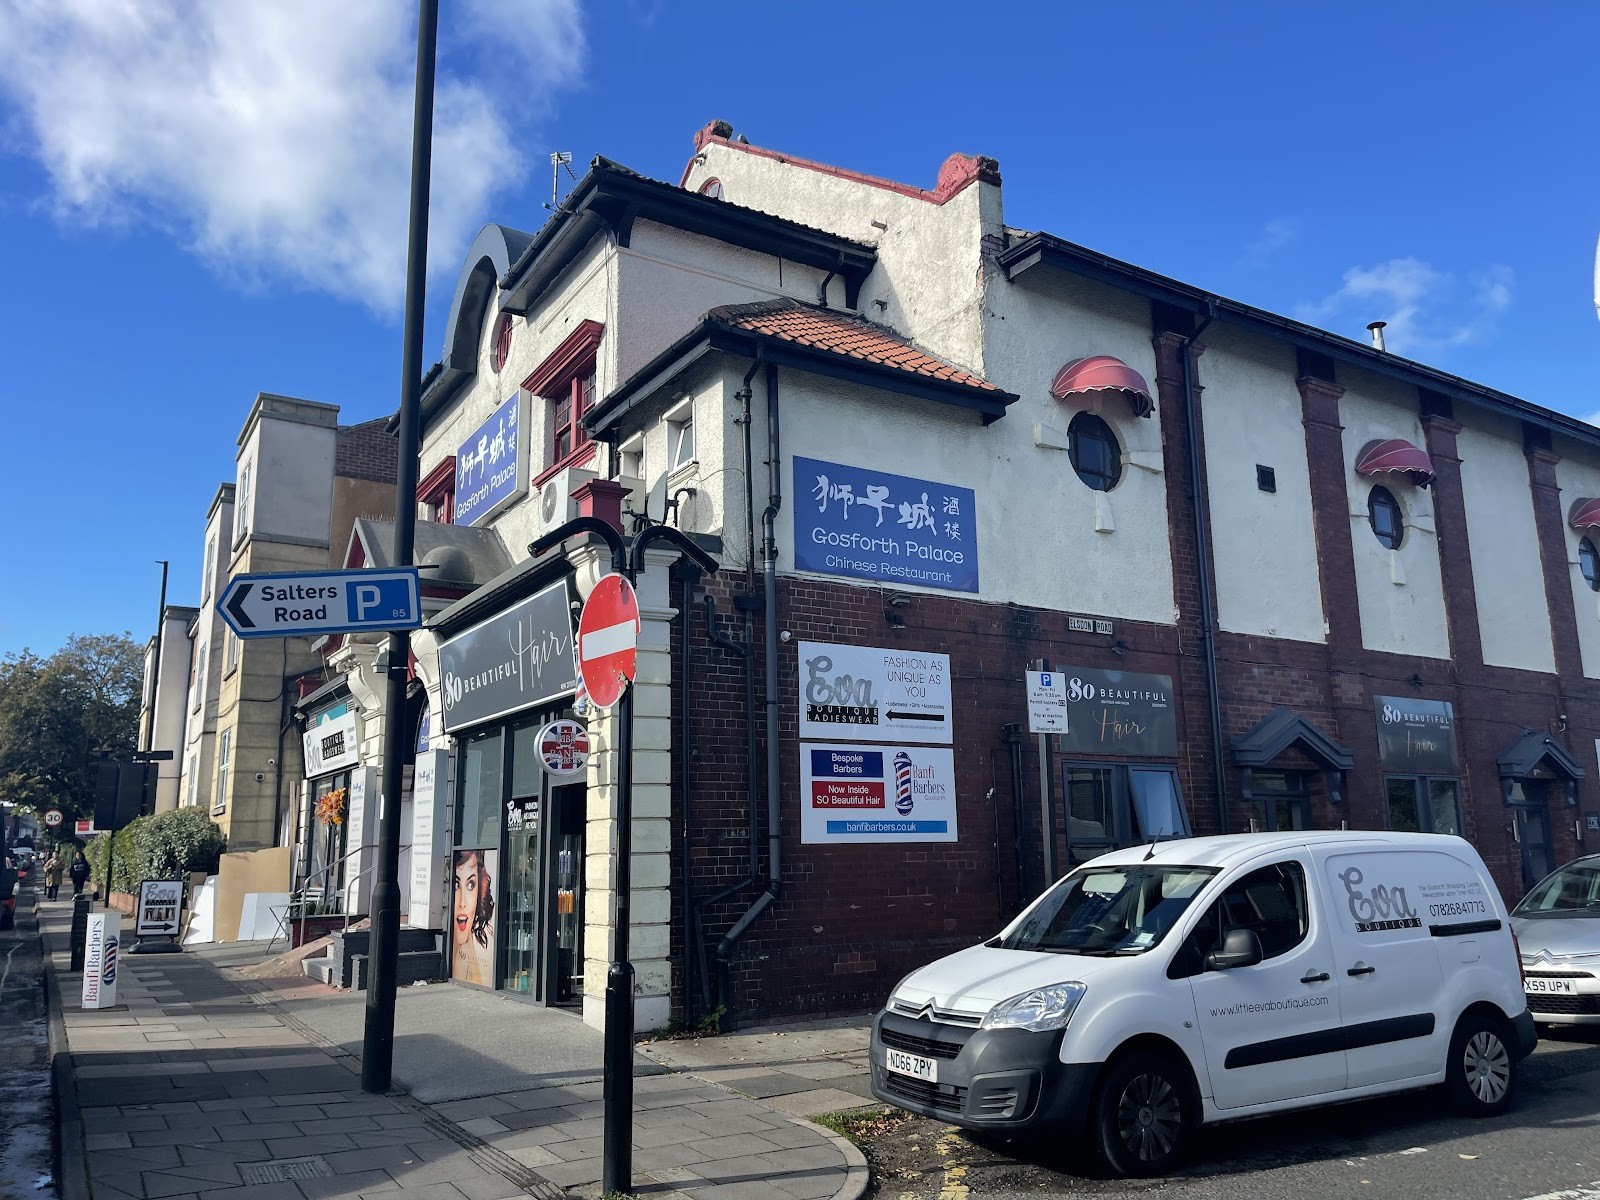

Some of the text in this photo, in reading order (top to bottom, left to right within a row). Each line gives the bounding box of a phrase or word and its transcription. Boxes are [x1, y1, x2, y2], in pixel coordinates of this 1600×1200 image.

[457, 462, 516, 518] Gosforth Palace
[812, 527, 964, 564] Gosforth Palace
[826, 555, 952, 583] Chinese Restaurant
[261, 585, 381, 620] Salters P
[274, 605, 406, 622] Road 85
[1070, 619, 1112, 632] ELSDON ROAD
[509, 614, 567, 692] Hair
[884, 656, 943, 671] FASHION AS
[464, 660, 517, 693] BEAUTIFUL
[805, 656, 878, 708] Eva
[888, 671, 941, 685] UNIQUE AS
[1043, 674, 1049, 685] P
[905, 686, 926, 697] YOU
[1100, 689, 1166, 701] BEAUTIFUL
[807, 705, 878, 716] BOUTIQUE
[807, 714, 878, 724] LADIESWEAR
[1093, 709, 1146, 742] Hair
[1404, 714, 1449, 724] BEAUTIFUL
[832, 753, 863, 763] Bespoke
[833, 764, 863, 773] Barbers
[913, 765, 935, 779] Banfi
[828, 785, 869, 794] Now Inside
[913, 780, 945, 794] Barbers
[816, 796, 880, 804] SO Beautiful Hair
[846, 822, 916, 832] banfibarbers.co.uk
[1338, 867, 1416, 924] Eva
[1430, 901, 1485, 916] 07826841773
[1356, 918, 1421, 932] BOUTIQUE
[85, 921, 102, 1002] Banfi Barbers
[1549, 982, 1570, 991] UPW
[1210, 996, 1329, 1017] www.littleevaboutique.com
[890, 1052, 932, 1076] ND66 ZPY
